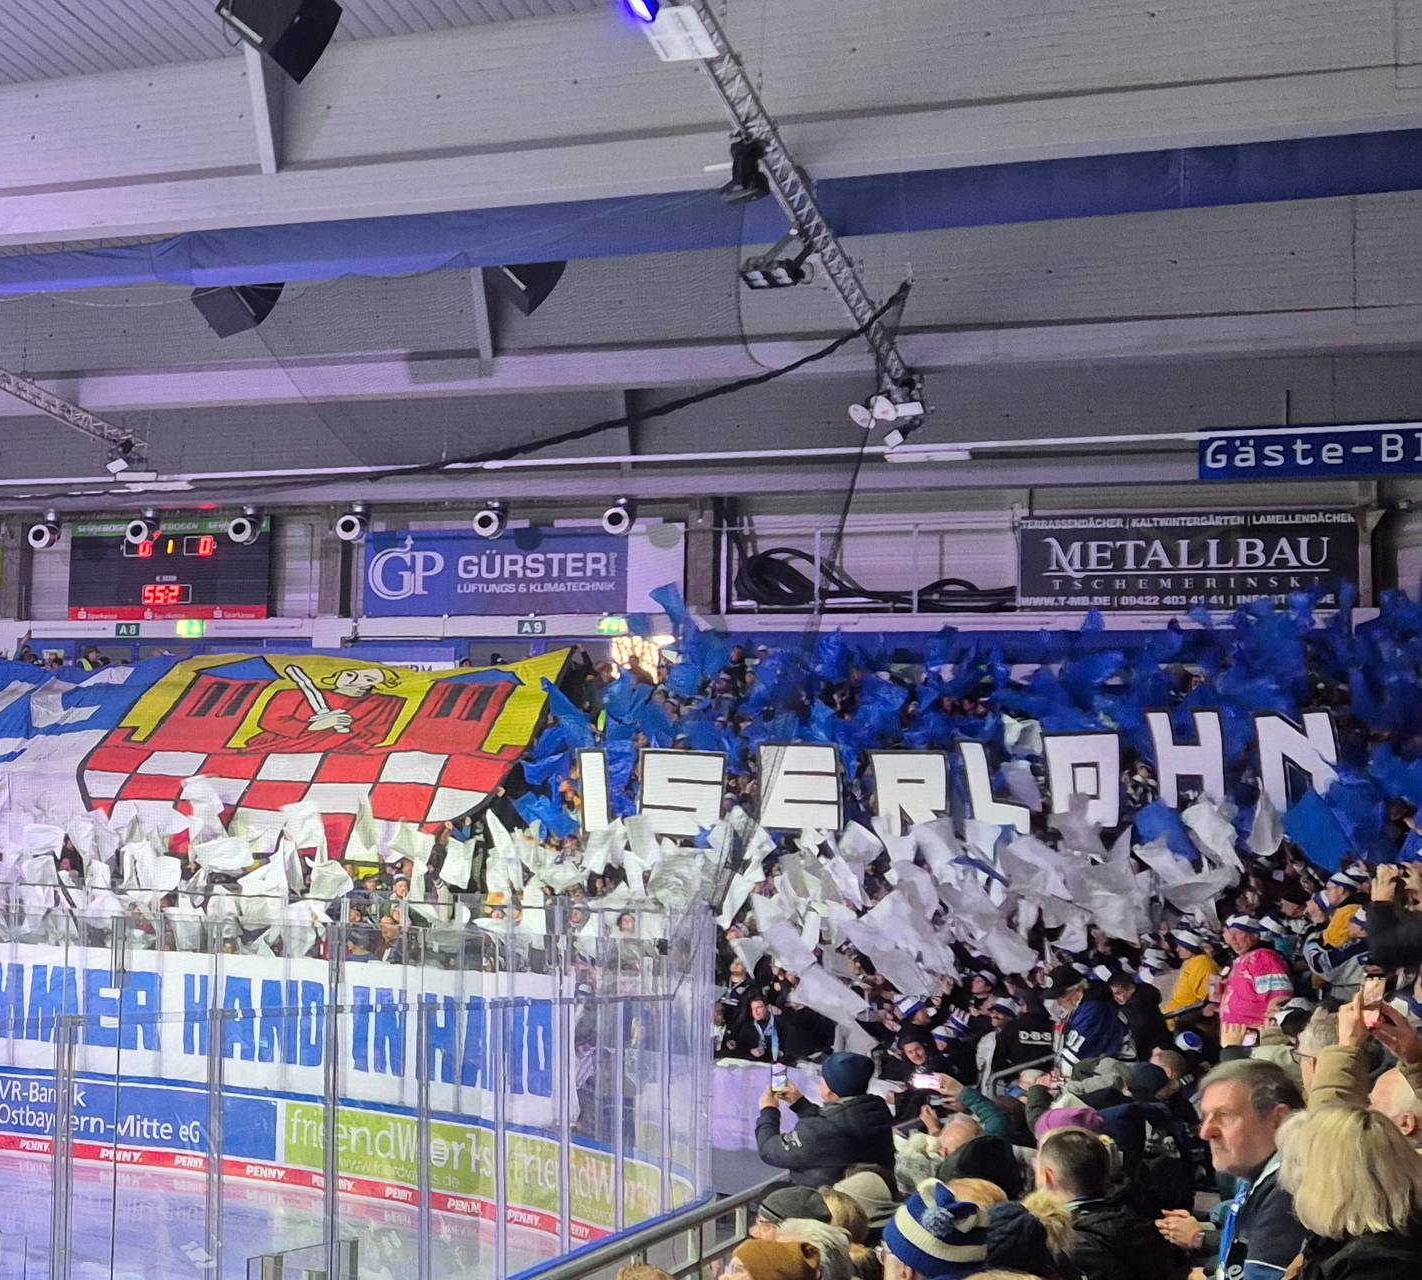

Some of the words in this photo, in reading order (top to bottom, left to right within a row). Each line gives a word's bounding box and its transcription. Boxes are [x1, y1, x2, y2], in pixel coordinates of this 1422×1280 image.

[1131, 515, 1245, 527] KALTWINTERGÄRTEN
[199, 535, 214, 557] 0
[1042, 536, 1330, 574] METALLBAU
[457, 549, 606, 579] GÜRSTER
[457, 582, 516, 594] LÜFTUNGS
[518, 582, 527, 593] &
[529, 581, 616, 593] KLIMATECHNIK
[1020, 596, 1111, 606] WWW.T-MB.DE
[1121, 595, 1160, 606] 09422
[1162, 594, 1187, 605] 403
[1190, 594, 1205, 604] 41
[183, 973, 325, 1067] HAND
[352, 985, 408, 1078] IN
[179, 1121, 200, 1144] eG
